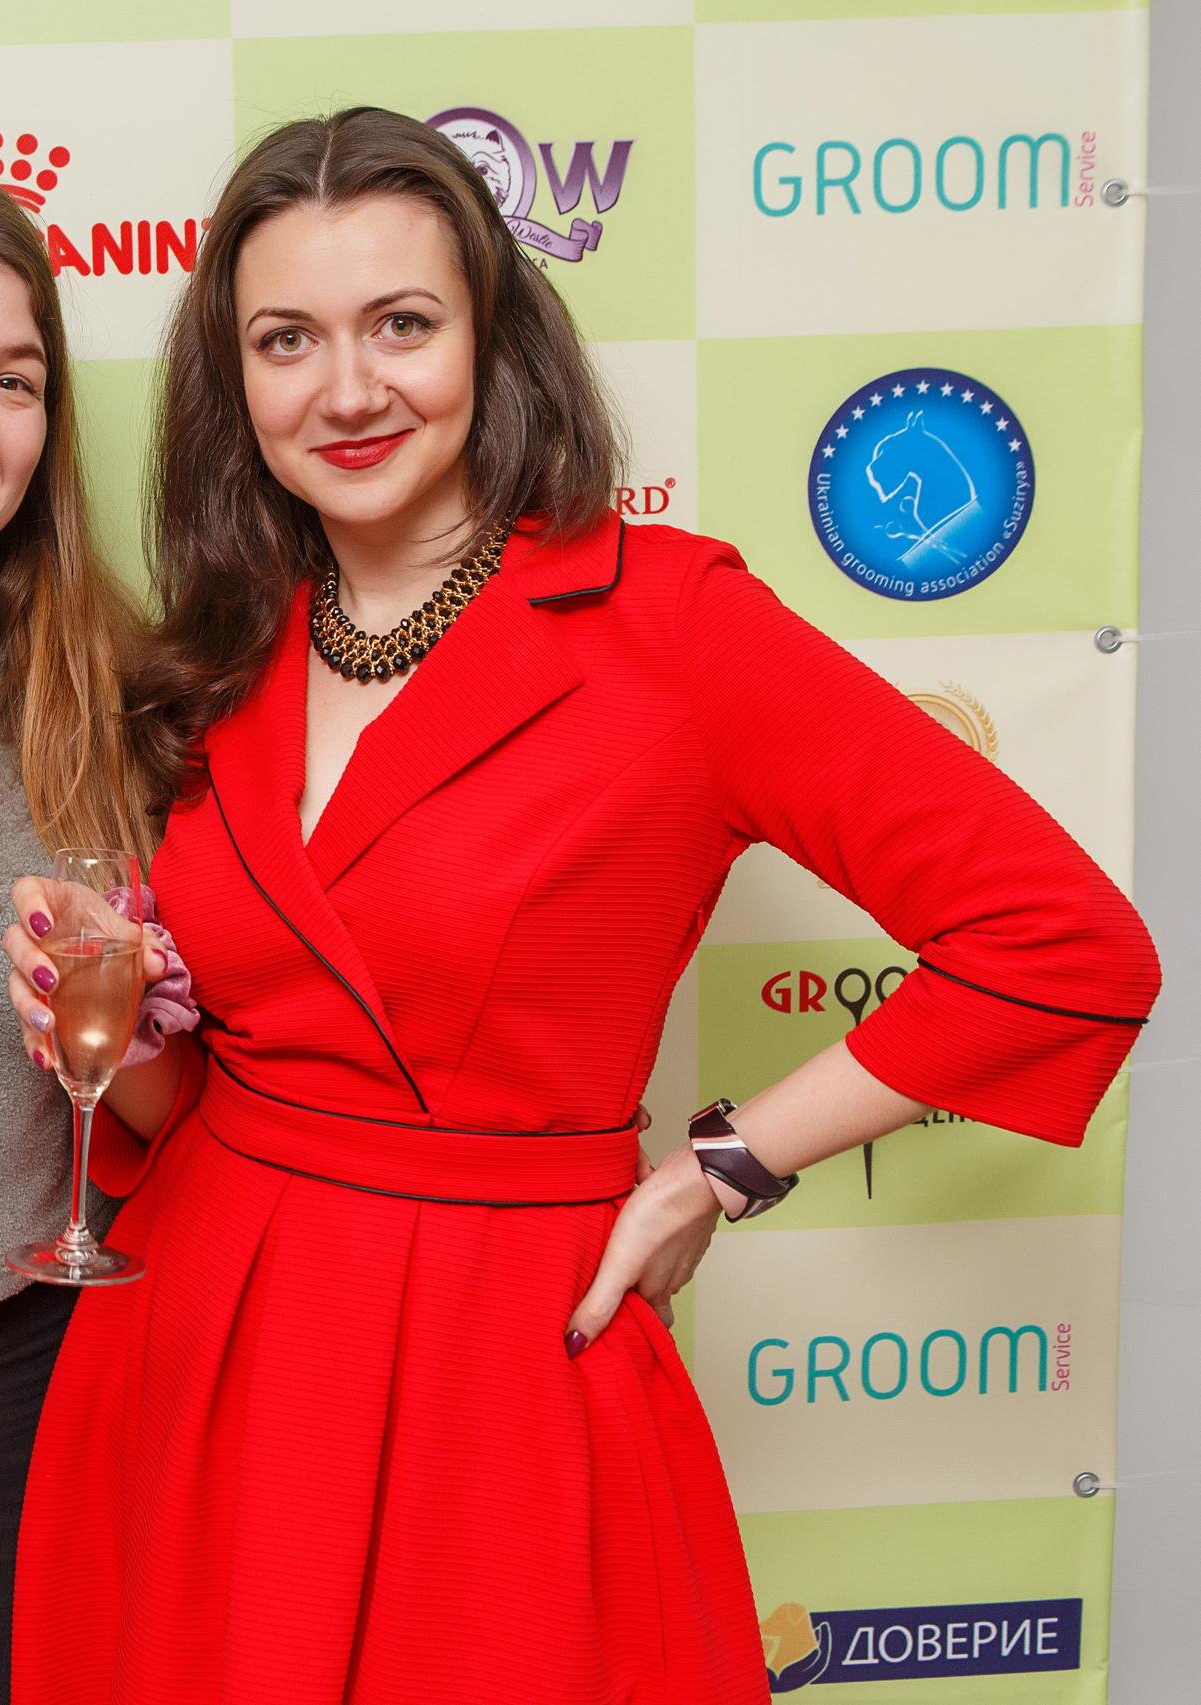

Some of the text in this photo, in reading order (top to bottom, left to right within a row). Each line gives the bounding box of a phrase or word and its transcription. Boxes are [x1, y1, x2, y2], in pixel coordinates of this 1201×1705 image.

[753, 130, 1097, 218] GROOM Service
[33, 218, 197, 277] ANIN
[816, 473, 845, 552] Ukrainian
[840, 552, 915, 597] grooming
[920, 541, 1004, 594] association
[747, 1322, 1072, 1407] GROOM Service
[841, 1617, 1059, 1666] ДОВЕРИЕ
